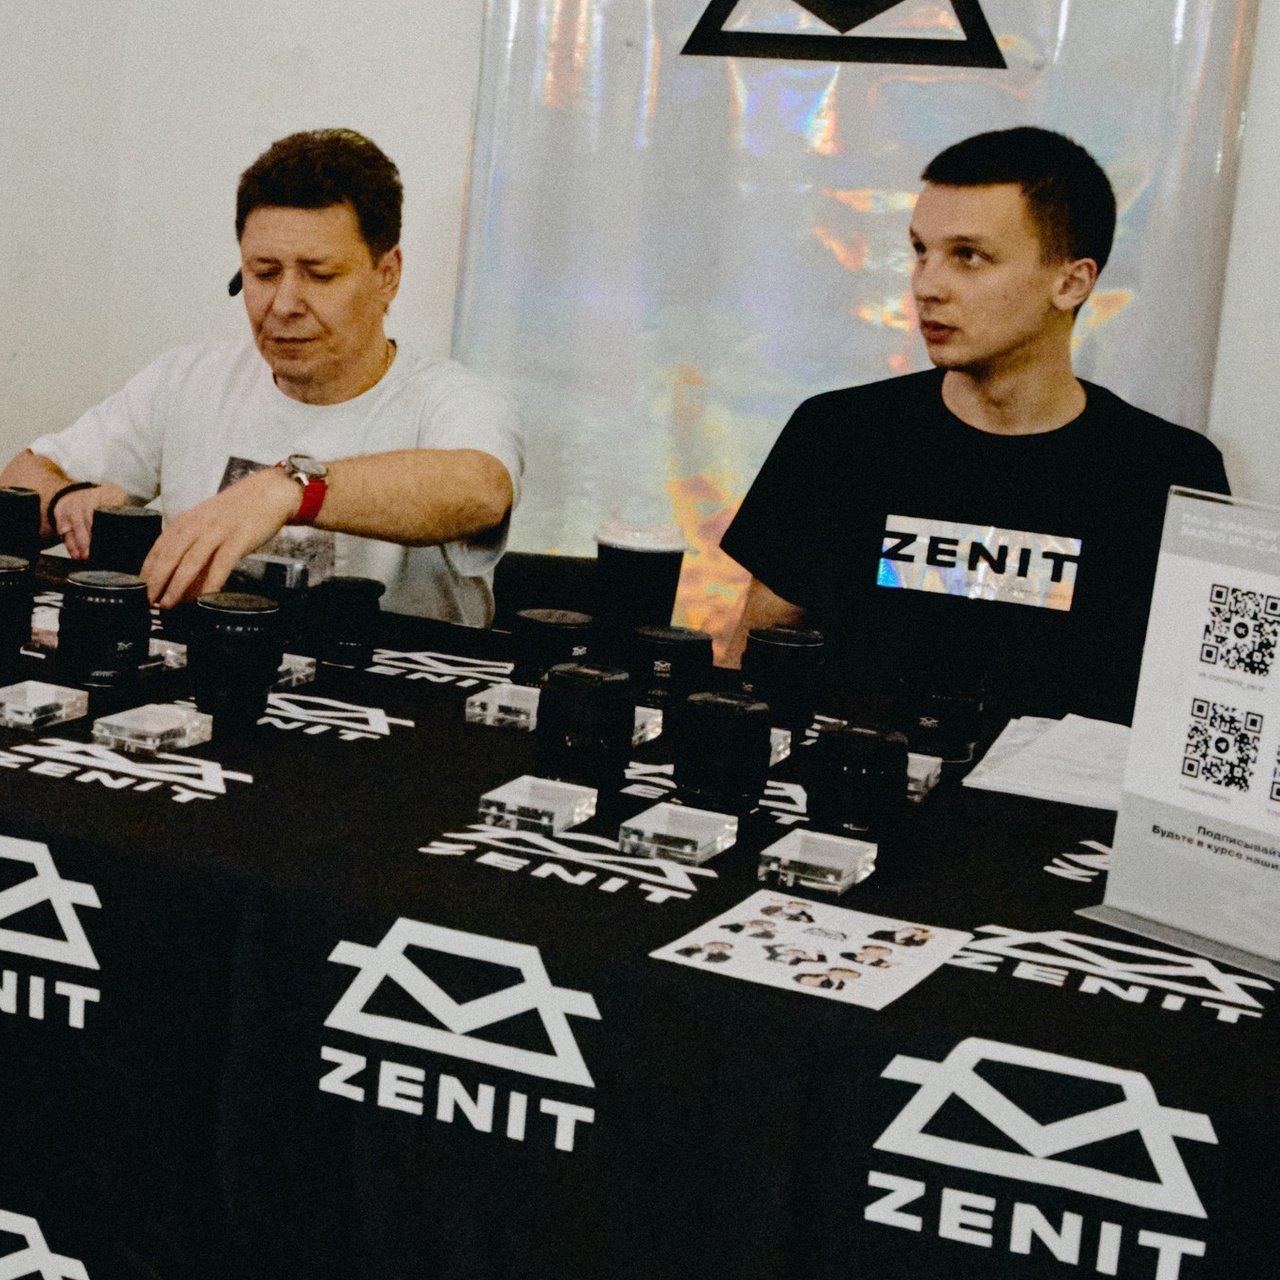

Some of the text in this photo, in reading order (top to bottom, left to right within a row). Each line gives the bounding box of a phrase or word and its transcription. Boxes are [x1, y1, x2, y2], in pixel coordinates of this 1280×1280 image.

[882, 531, 1078, 582] ZENIT
[418, 842, 692, 903] ZENIT
[1152, 824, 1194, 847] Будьте
[1207, 843, 1243, 861] курсе
[947, 948, 1262, 1023] ZENIT
[319, 1045, 595, 1152] ZENIT
